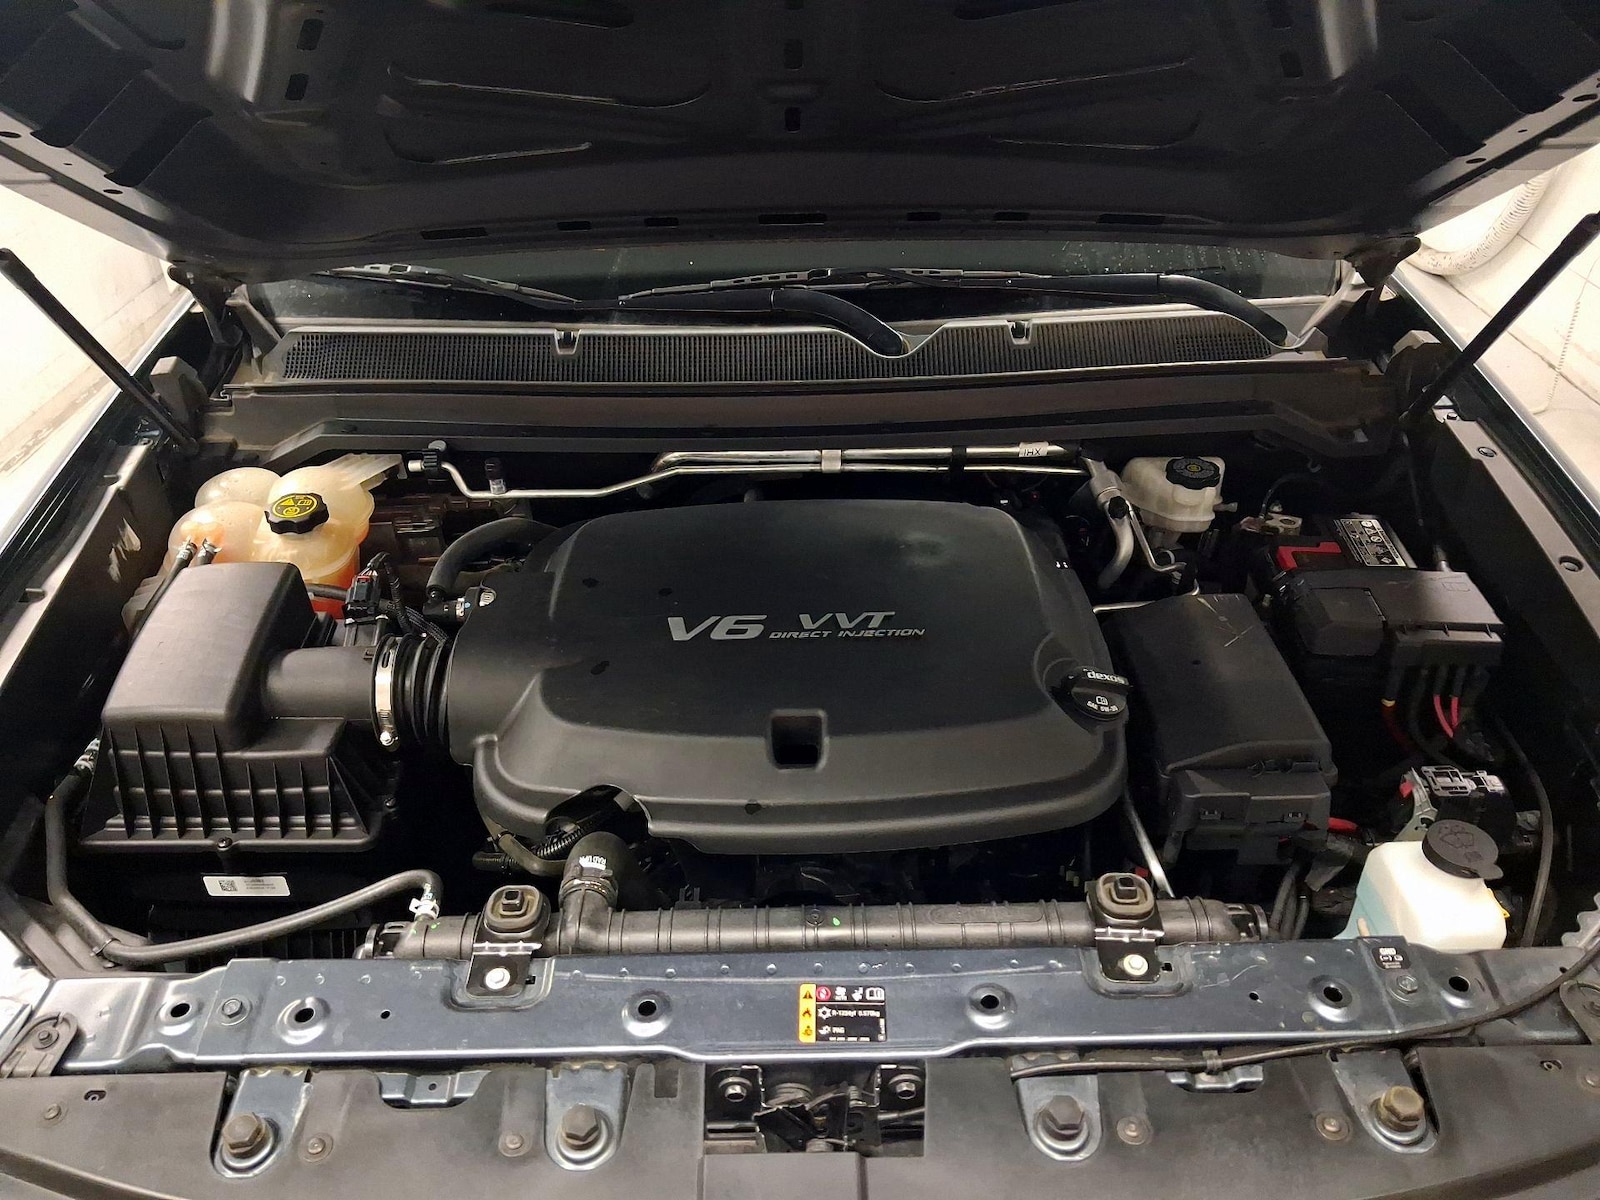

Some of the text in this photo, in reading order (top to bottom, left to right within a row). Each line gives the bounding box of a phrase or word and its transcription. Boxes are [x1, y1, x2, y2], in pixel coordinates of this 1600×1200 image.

[667, 614, 768, 641] V6
[799, 611, 896, 629] VVT
[769, 628, 926, 639] DIRECT INJECTION
[1087, 671, 1125, 684] dexos
